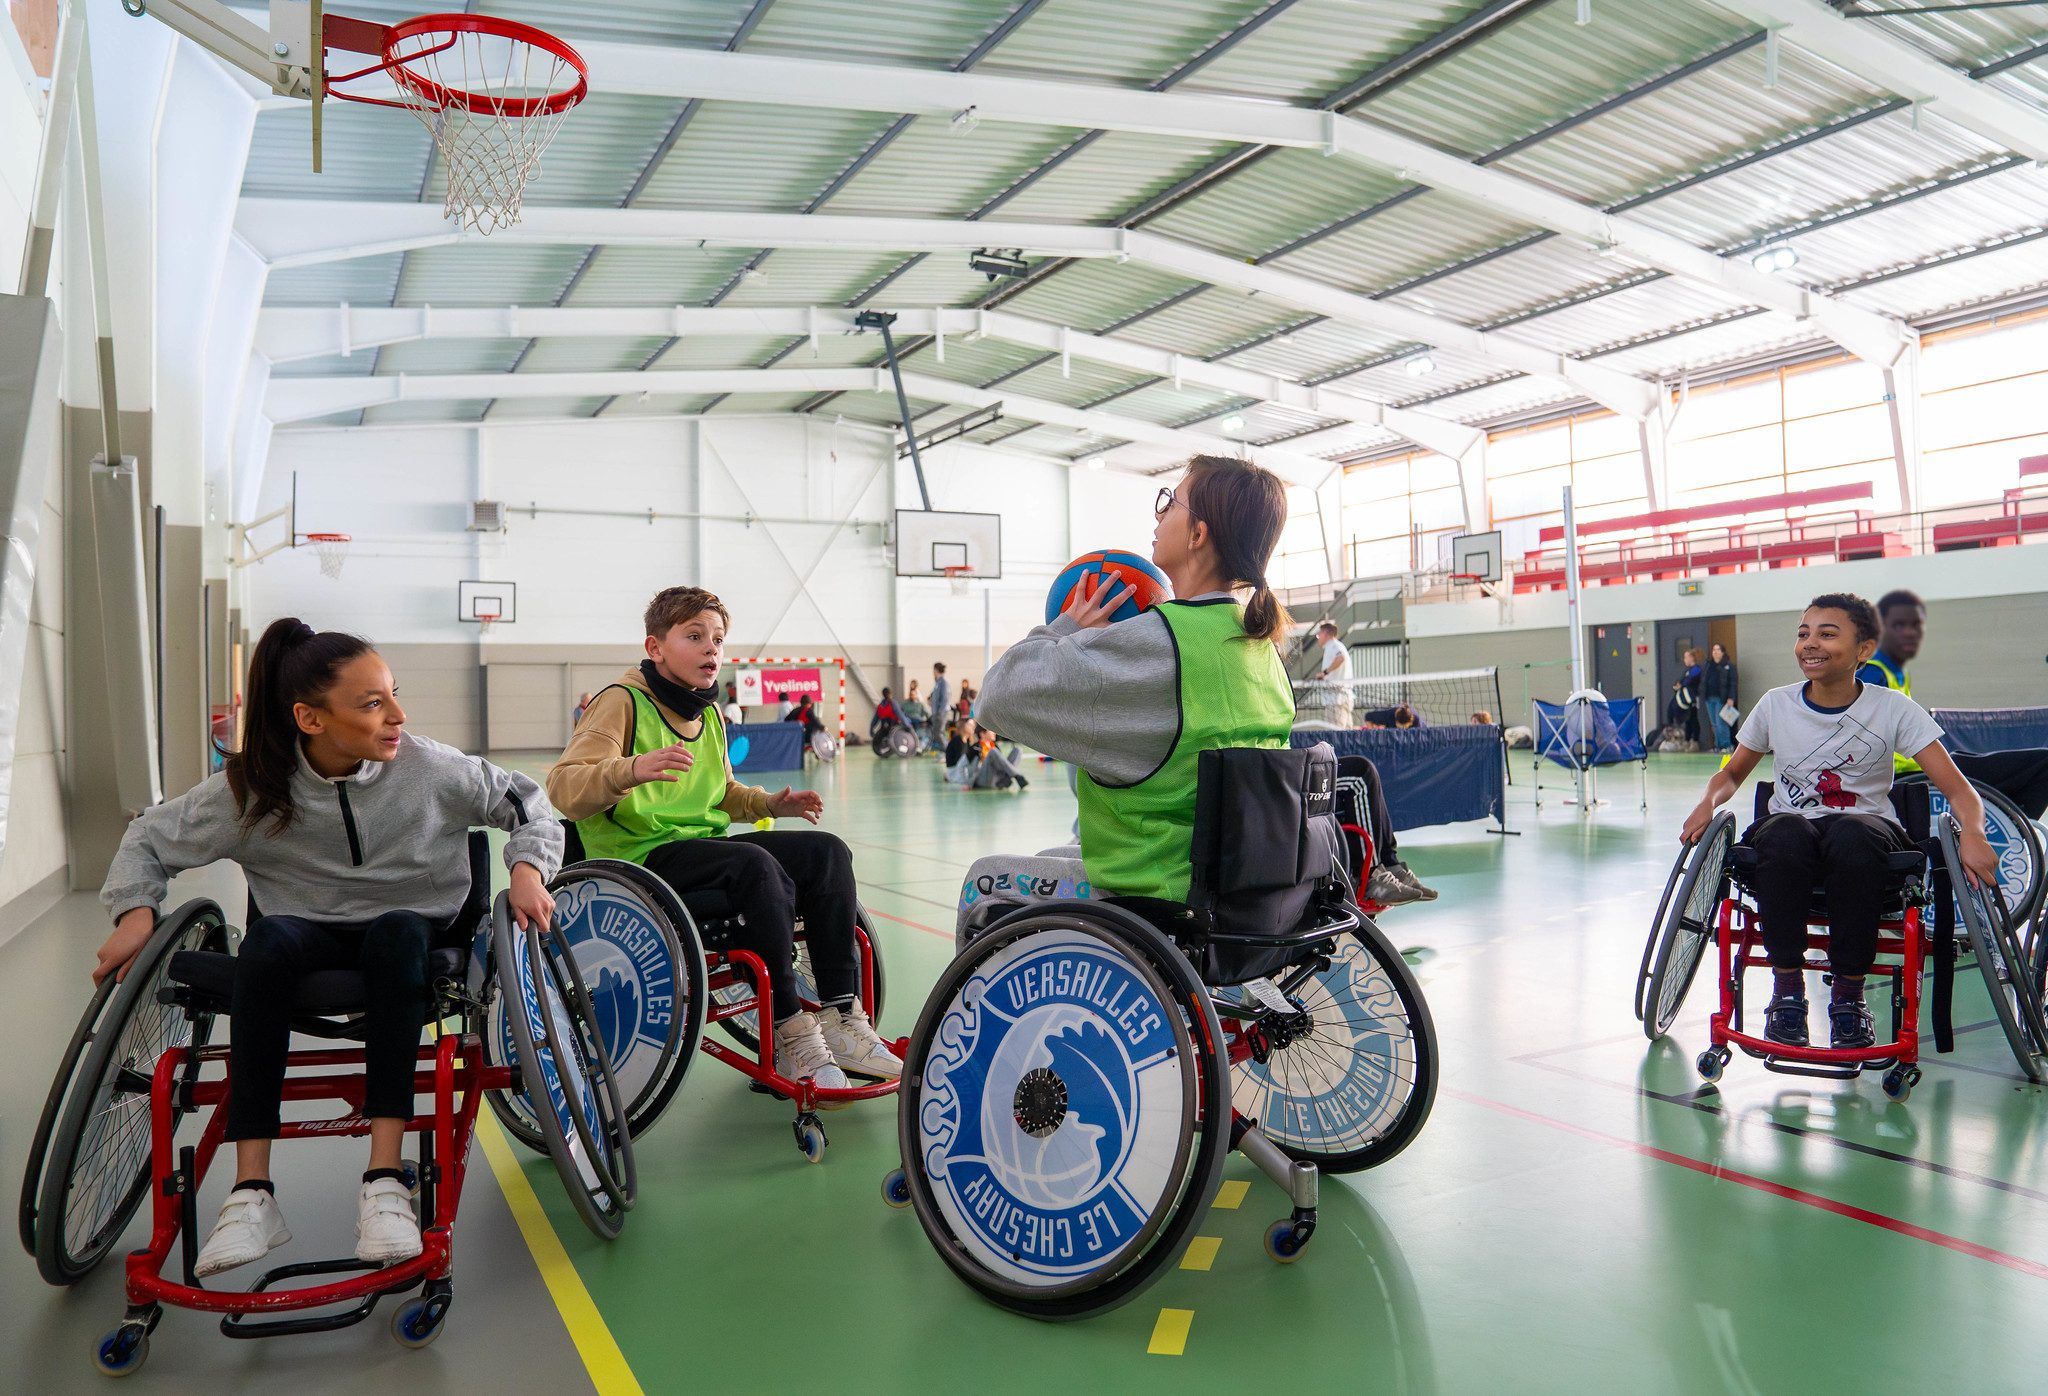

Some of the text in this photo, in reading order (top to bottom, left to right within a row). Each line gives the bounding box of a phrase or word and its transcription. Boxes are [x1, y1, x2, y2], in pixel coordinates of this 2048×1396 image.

[764, 680, 819, 693] Yvelines
[600, 906, 672, 1025] VERSAILLES
[1007, 959, 1162, 1046] VERSAILLES
[298, 1122, 327, 1130] Top
[326, 1120, 357, 1128] End
[964, 1173, 1121, 1258] LE CHESNAY
